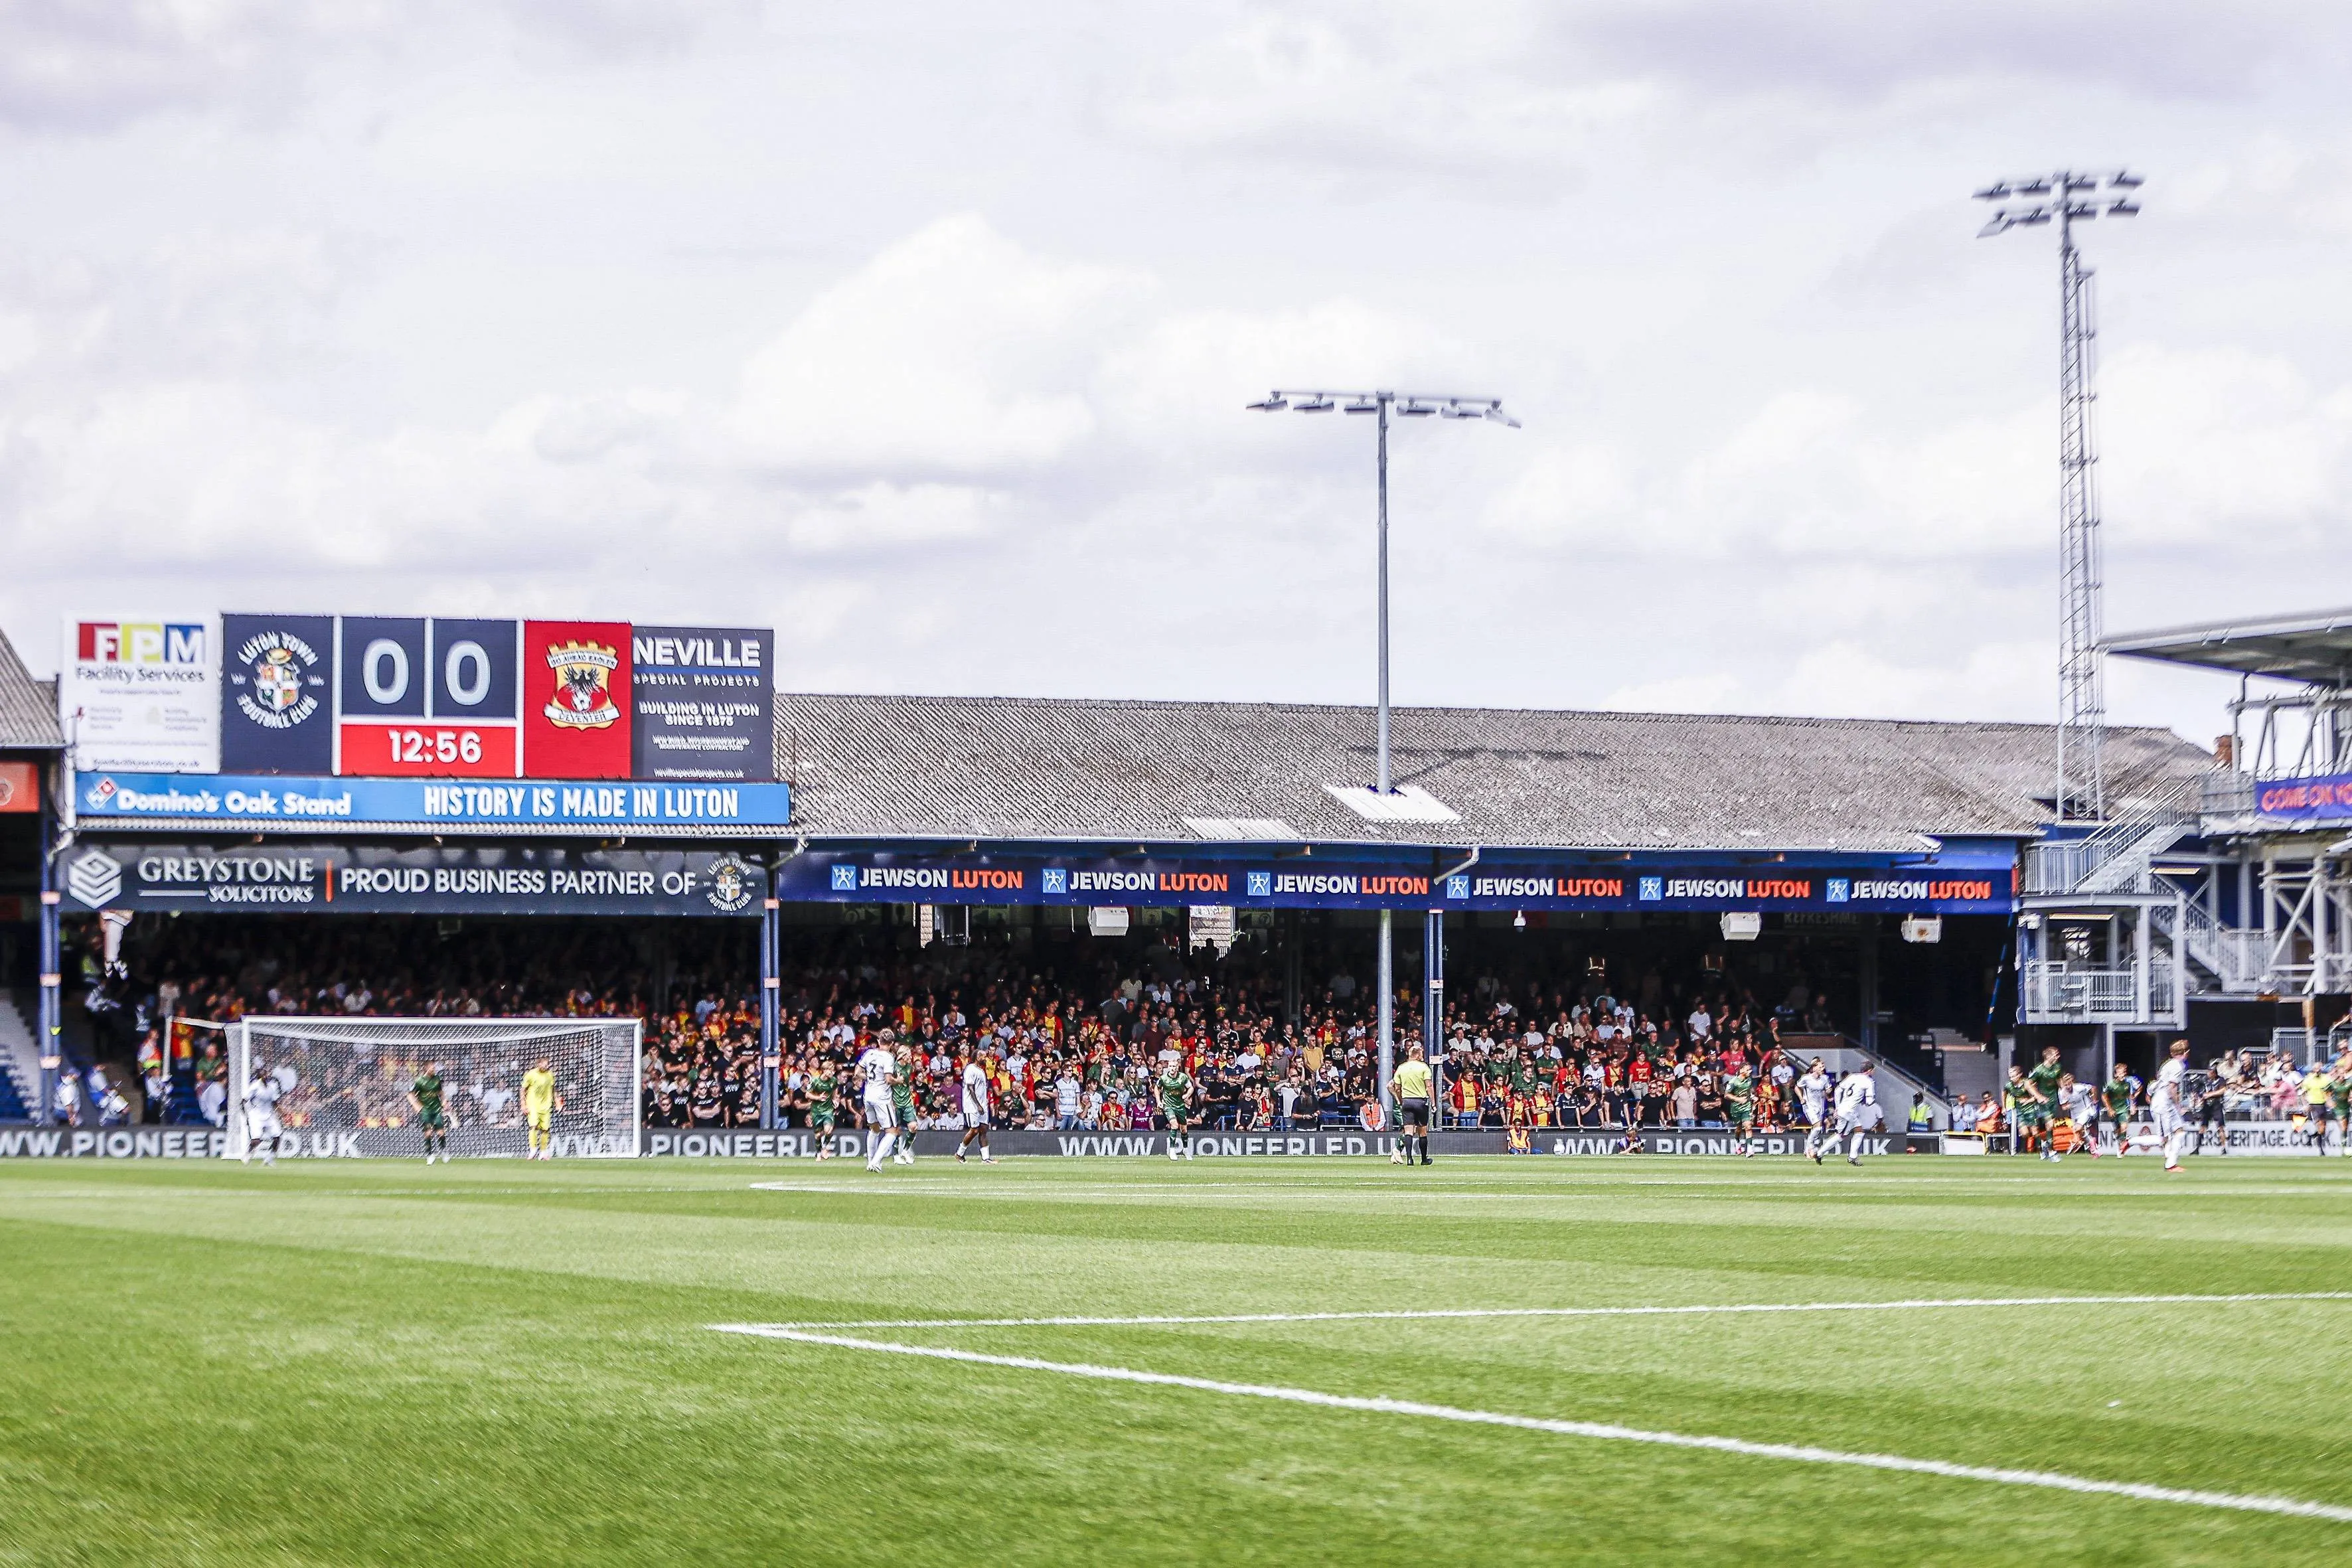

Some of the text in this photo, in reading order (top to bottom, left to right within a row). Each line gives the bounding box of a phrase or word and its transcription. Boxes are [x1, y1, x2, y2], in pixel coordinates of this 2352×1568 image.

[78, 623, 205, 663] FPM
[237, 631, 319, 666] LUTON TOWN
[633, 637, 761, 667] NEVILLE
[76, 665, 205, 684] Facility Services
[362, 638, 409, 704] 0
[445, 639, 491, 706] 0
[633, 673, 760, 687] SPECIAL PROJECTS
[236, 692, 293, 729] FOOTBALL
[289, 694, 319, 725] CLUB
[639, 701, 760, 717] BUILDING IN LUTON
[665, 714, 704, 726] SINCE
[388, 728, 482, 764] 12:56
[117, 789, 352, 816] Domino's Oak Stand
[424, 786, 739, 819] HISTORY IS MADE IN LUTON
[2262, 786, 2308, 813] COME
[137, 856, 314, 883] GREYSTONE
[860, 868, 1023, 889] JEWSON LUTON
[341, 868, 697, 896] PROUD BUSINESS PARTNER OF
[1069, 872, 1228, 892] JEWSON LUTON
[1275, 874, 1429, 894] JEWSON LUTON
[1472, 878, 1622, 897] JEWSON LUTON
[1665, 880, 1810, 898] JEWSON LUTON
[1851, 881, 1991, 900] JEWSON LUTON
[208, 885, 314, 903] SOLICITORS
[868, 1063, 876, 1081] 3
[1846, 1083, 1854, 1097] 6
